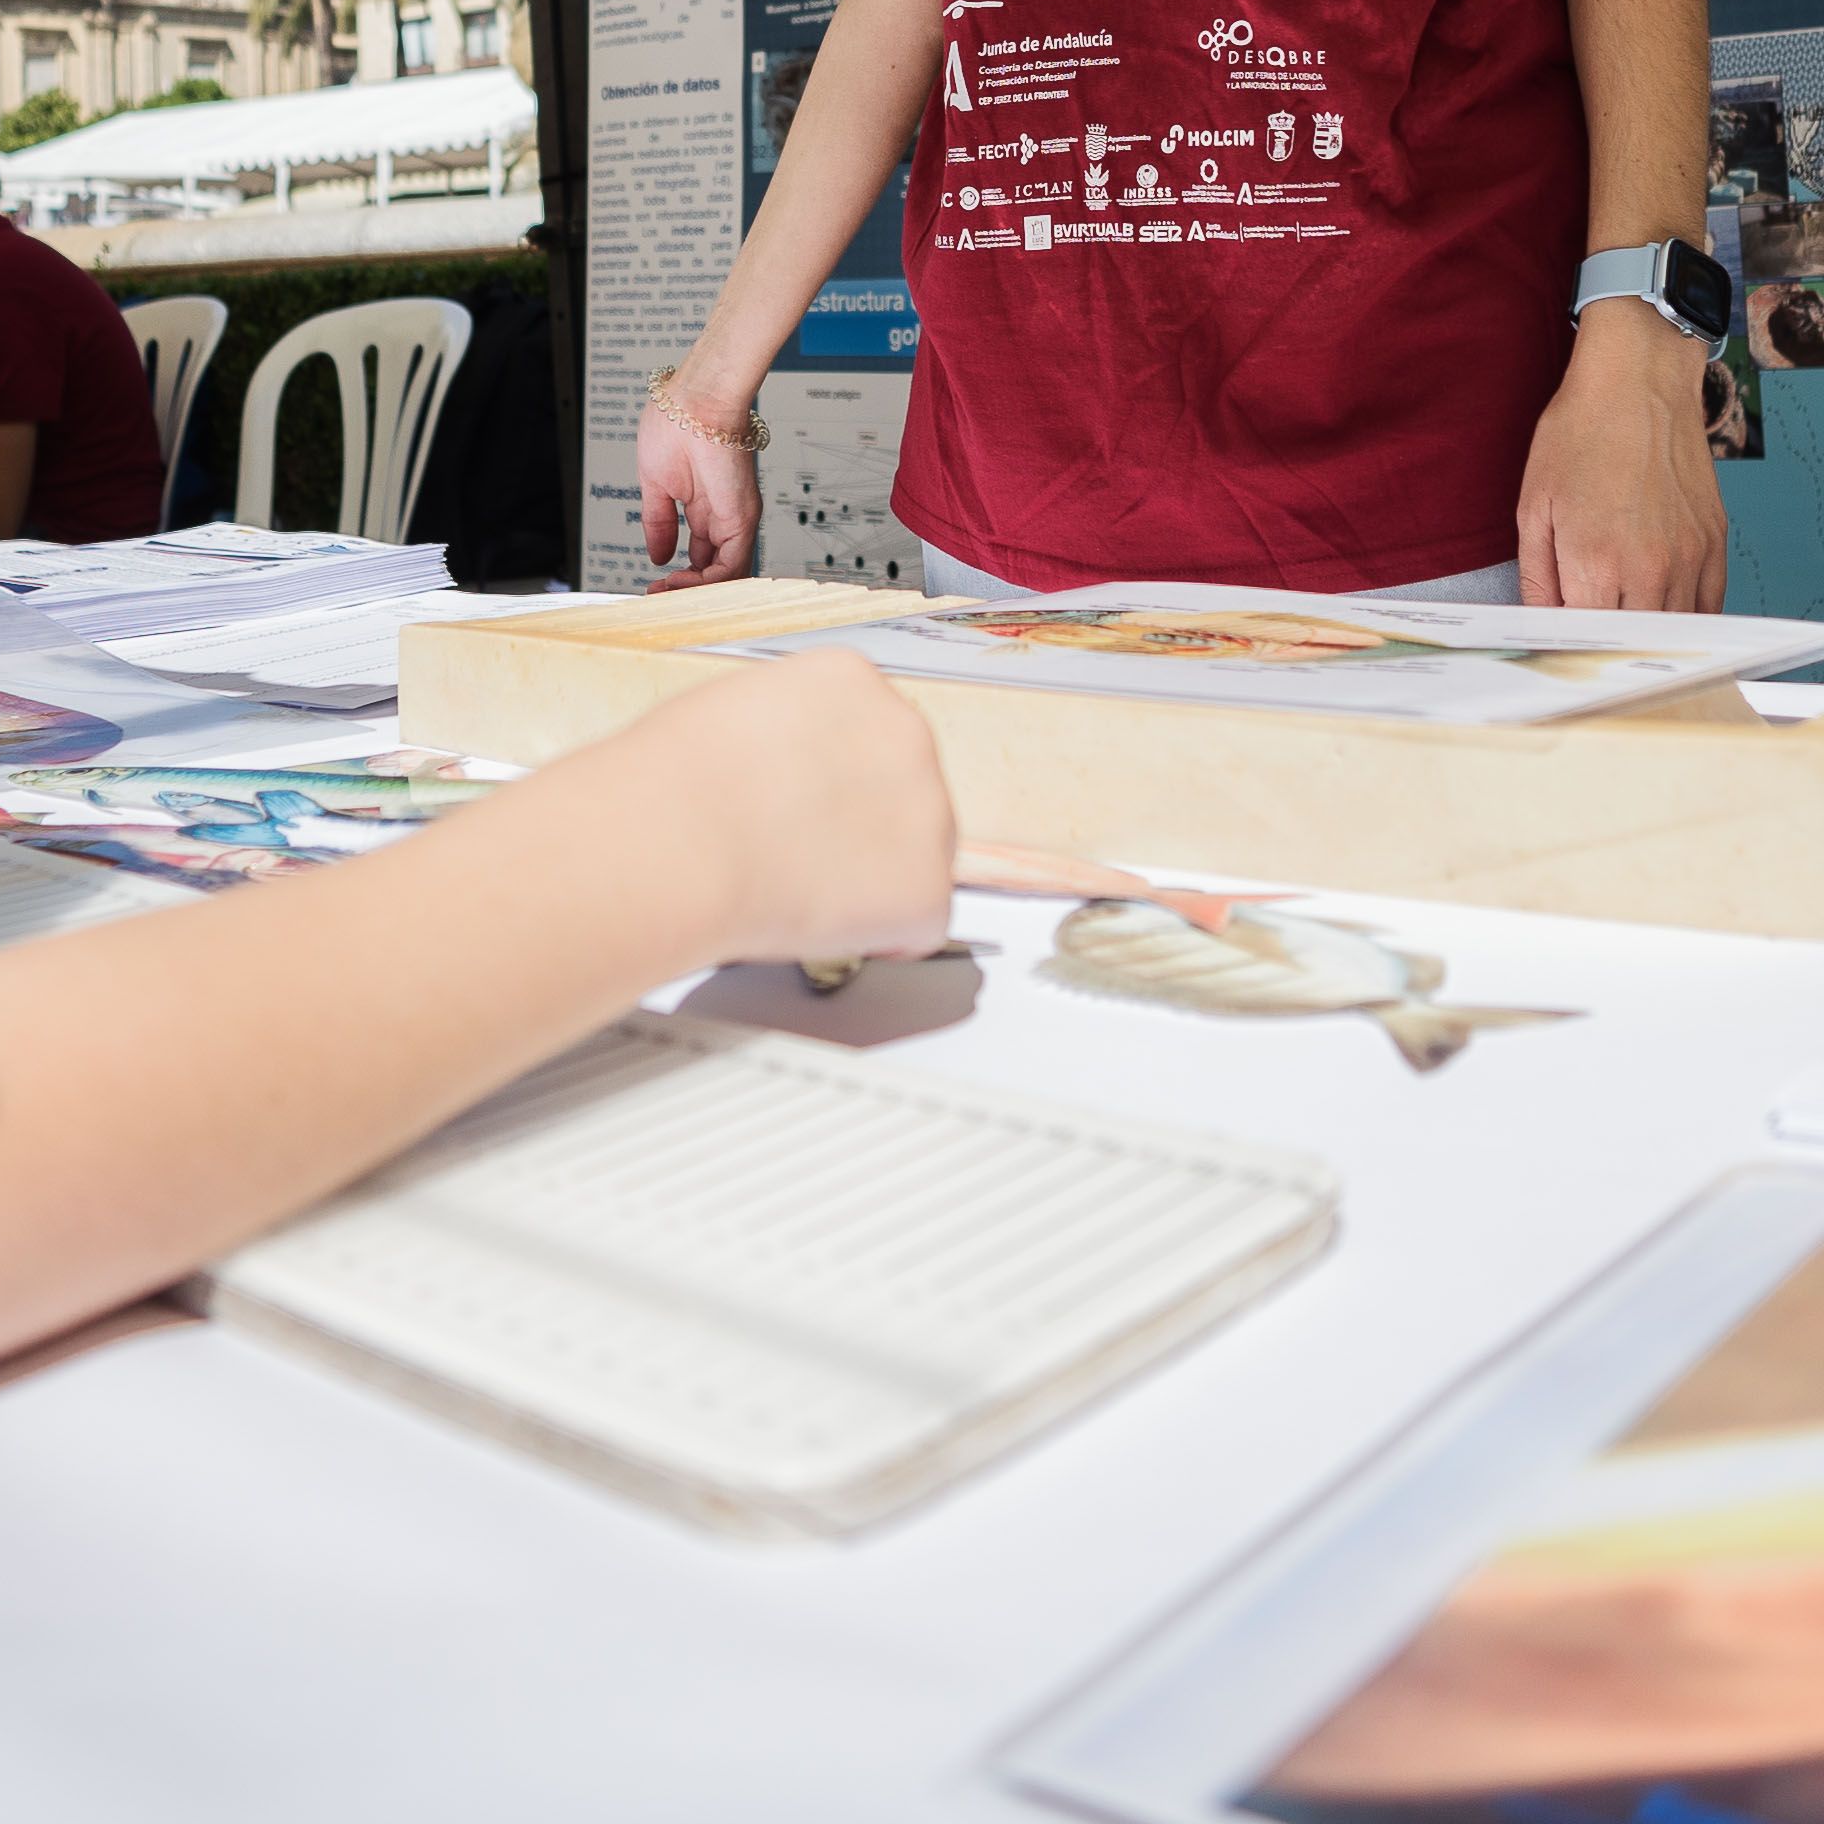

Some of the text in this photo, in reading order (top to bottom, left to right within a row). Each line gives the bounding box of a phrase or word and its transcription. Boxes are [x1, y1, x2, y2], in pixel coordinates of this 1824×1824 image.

[977, 29, 1113, 57] Junta de Andalucía
[1022, 61, 1034, 71] de
[663, 80, 679, 94] de
[683, 78, 721, 93] datos
[978, 79, 984, 90] y
[1187, 129, 1255, 146] HOLCIM
[978, 142, 1020, 160] FECYT
[1123, 186, 1172, 199] INDESS
[888, 323, 921, 352] gol
